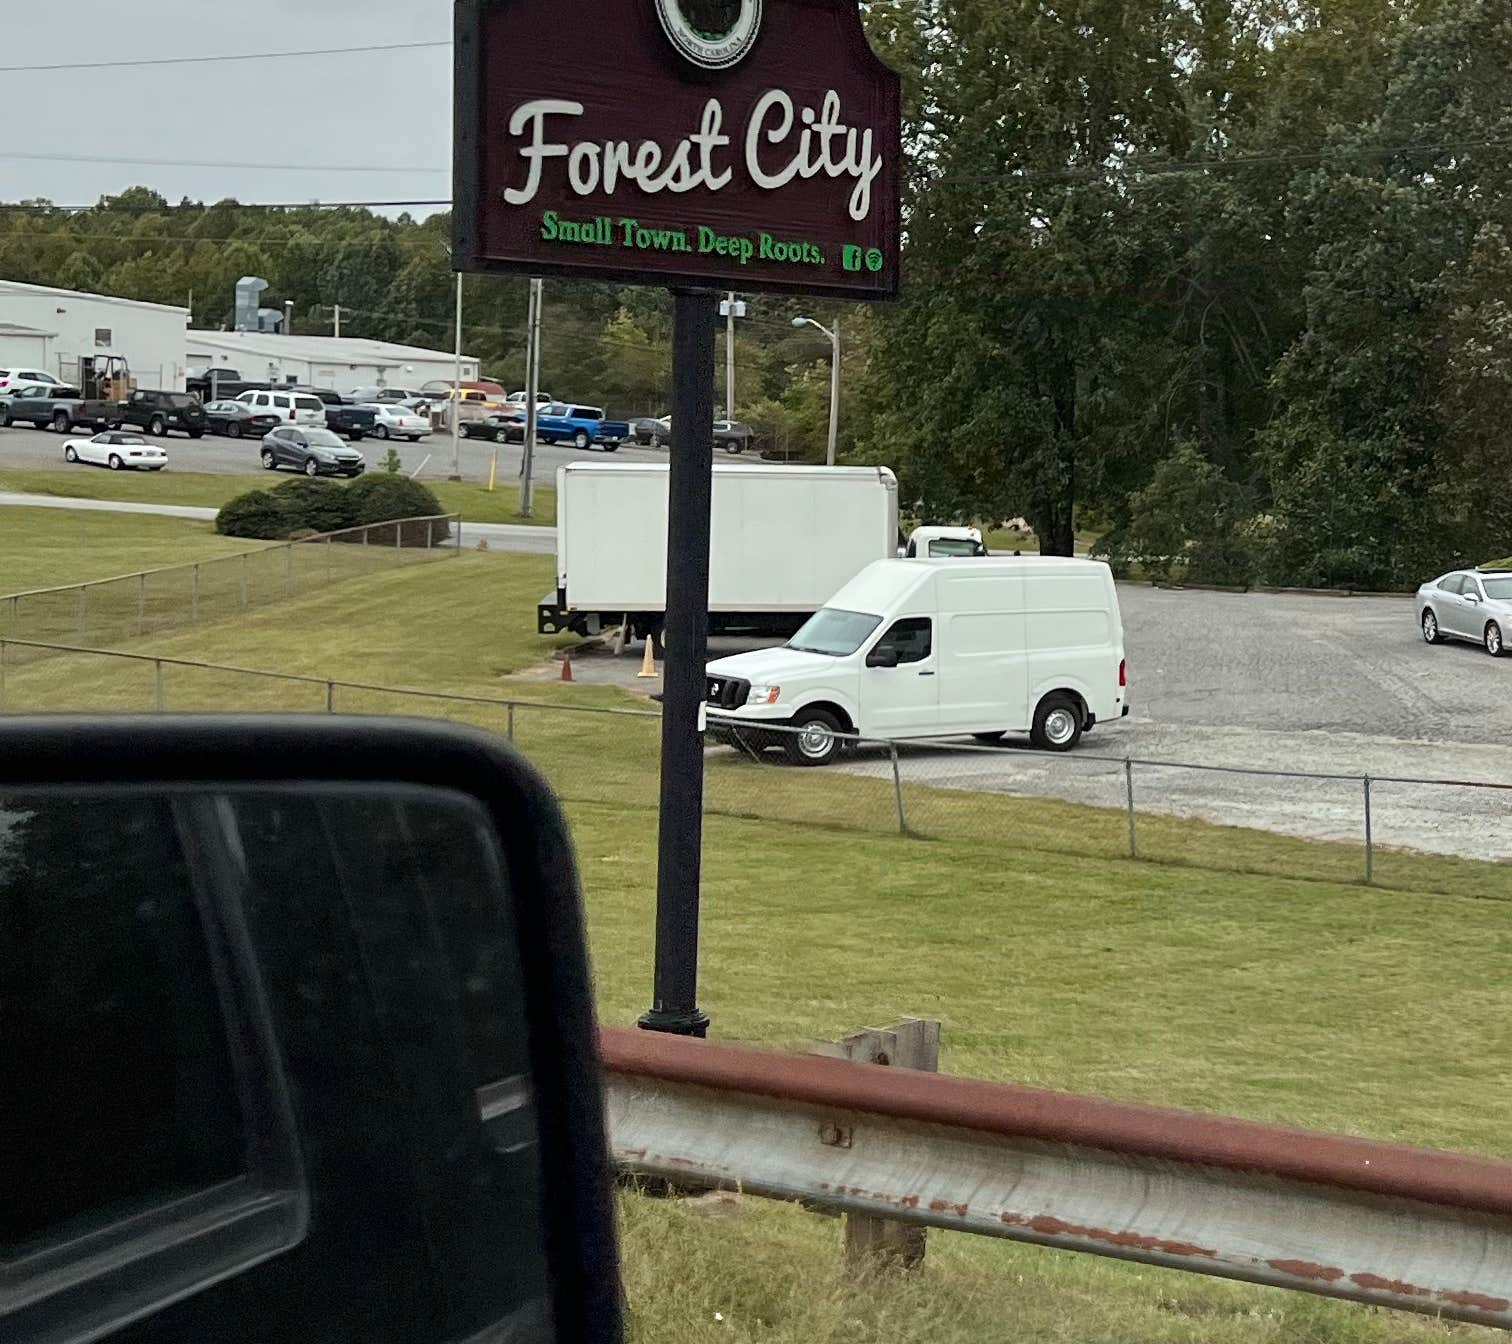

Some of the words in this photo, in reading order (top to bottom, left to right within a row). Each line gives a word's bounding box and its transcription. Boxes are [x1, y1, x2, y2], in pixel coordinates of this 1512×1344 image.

[503, 98, 732, 205] Forest
[745, 89, 883, 221] City
[541, 211, 612, 244] Small
[620, 219, 692, 253] Town.
[698, 226, 753, 264] Deep
[759, 233, 826, 264] Roots.
